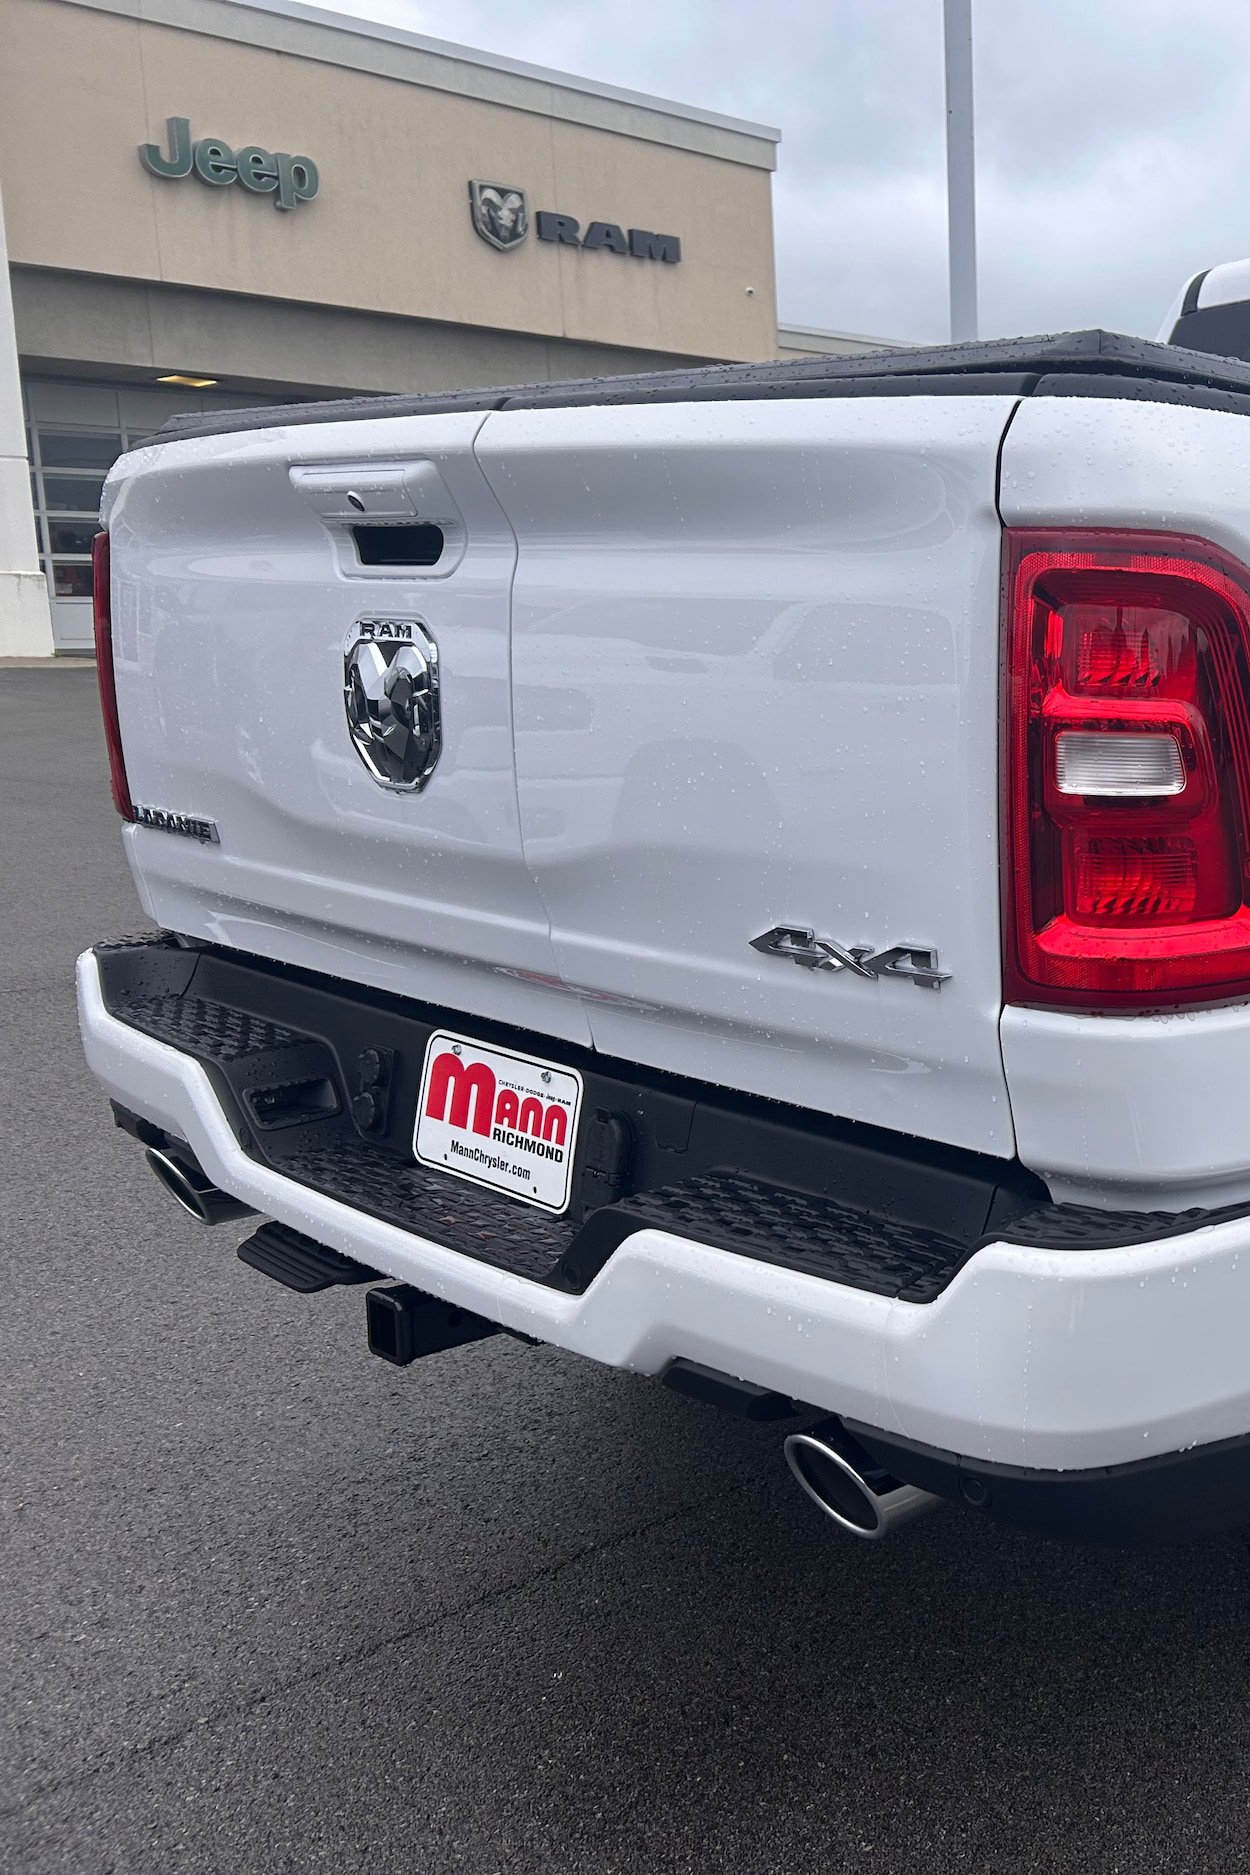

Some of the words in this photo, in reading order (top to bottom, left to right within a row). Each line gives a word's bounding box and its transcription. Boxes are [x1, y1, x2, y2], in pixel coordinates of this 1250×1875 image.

[139, 116, 320, 210] Jeep
[536, 210, 681, 263] RAM
[360, 622, 412, 639] RAM
[450, 1139, 531, 1181] MannChrysler.com
[492, 1127, 564, 1163] RICHMOND
